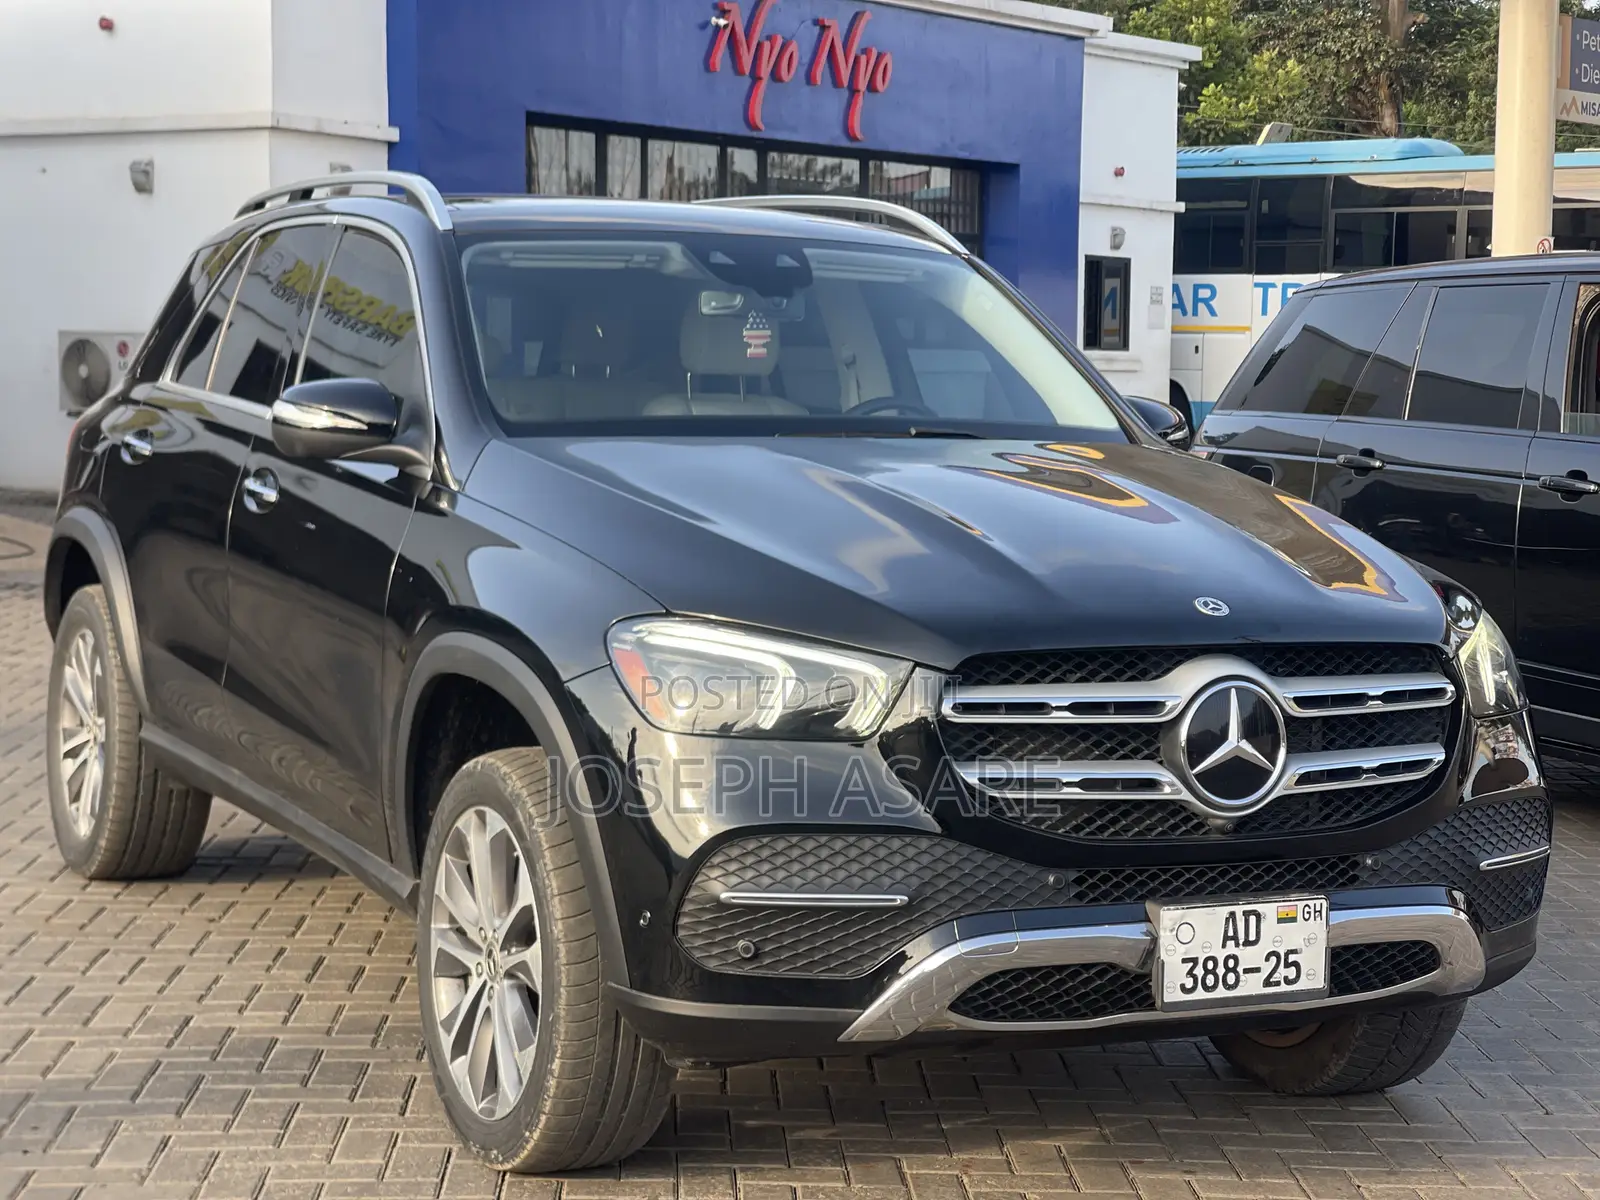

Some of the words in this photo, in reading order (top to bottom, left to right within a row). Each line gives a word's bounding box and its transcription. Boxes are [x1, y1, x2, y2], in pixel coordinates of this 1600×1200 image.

[709, 0, 799, 131] Nyo
[810, 10, 893, 141] Nyo
[1581, 63, 1600, 85] Die
[1221, 909, 1262, 949] AD
[1302, 903, 1323, 922] GH
[1179, 948, 1303, 995] 388-25
